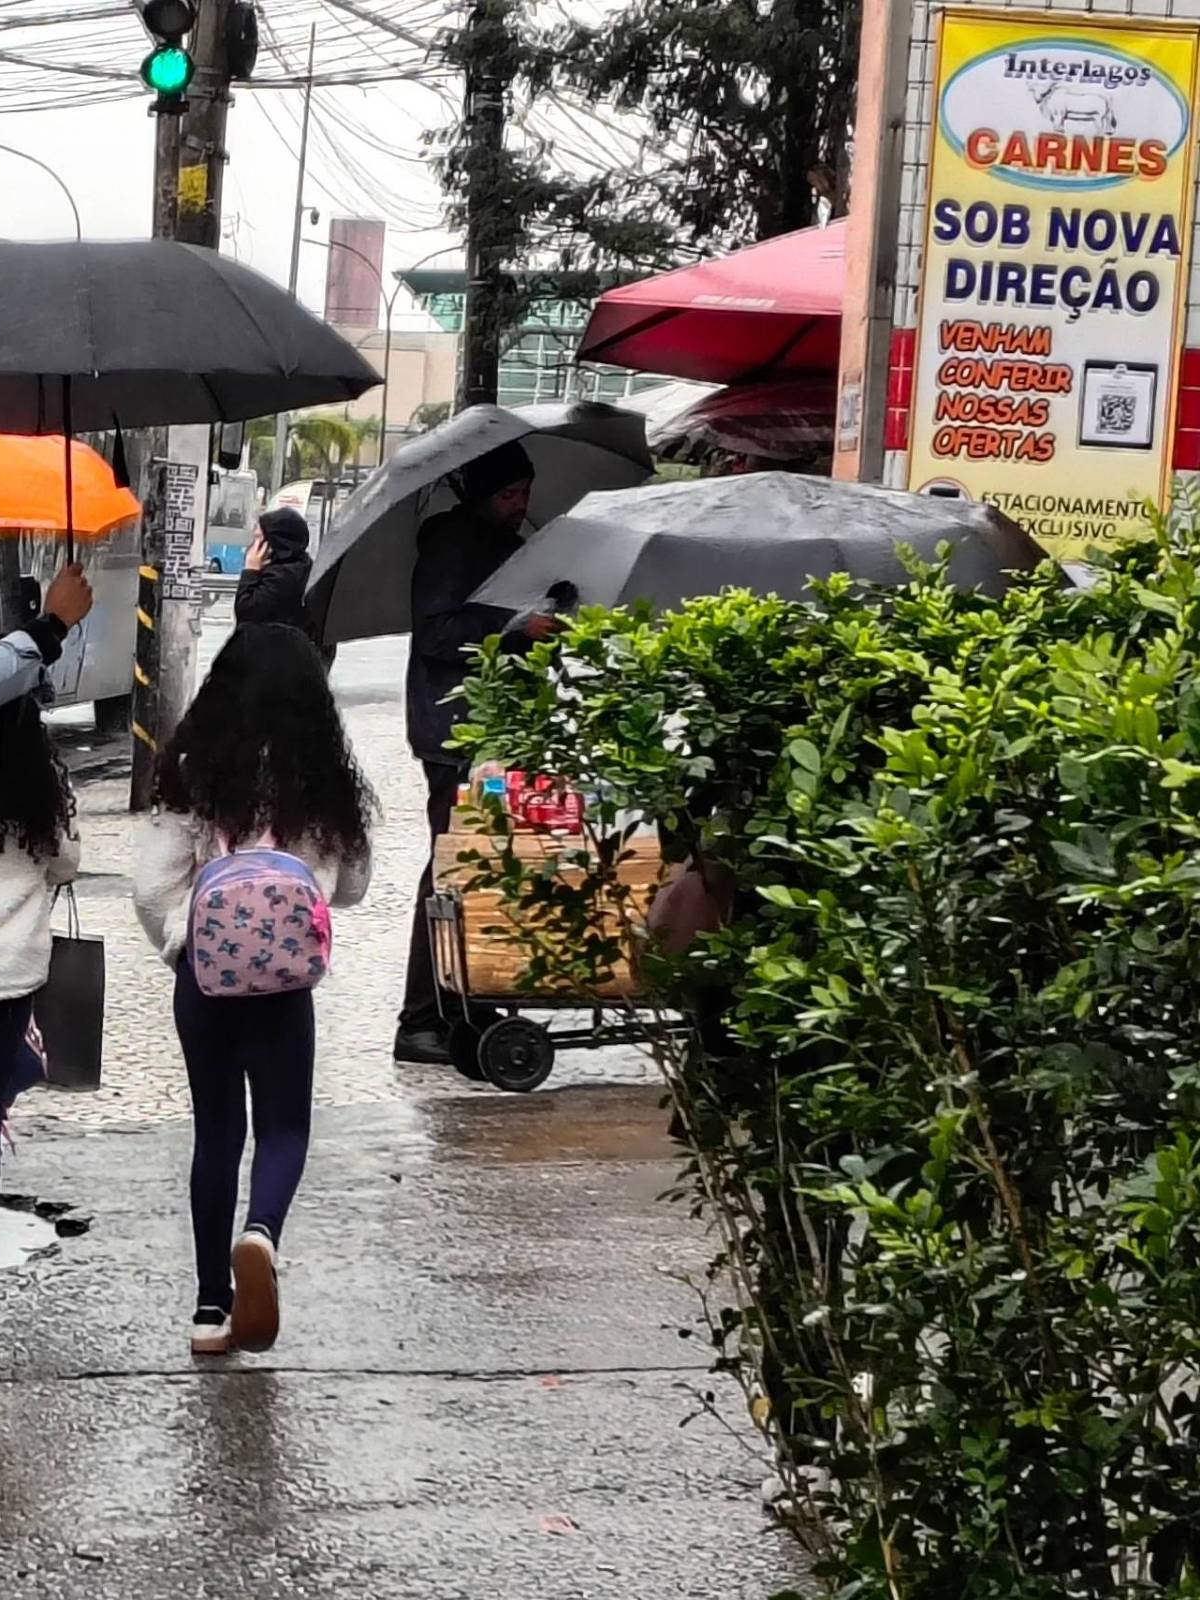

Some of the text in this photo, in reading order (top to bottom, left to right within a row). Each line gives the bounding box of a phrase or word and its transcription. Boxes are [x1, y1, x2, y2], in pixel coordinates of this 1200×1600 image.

[1004, 53, 1152, 89] Interlagos
[966, 128, 1166, 179] CARNES
[933, 197, 1182, 257] SOB NOVA
[944, 257, 1162, 322] DIREÇÃO
[939, 319, 1053, 356] VENHAM
[936, 357, 1074, 393] CONFERIR
[936, 393, 1050, 427] NOSSAS
[931, 427, 1056, 463] OFERTAS
